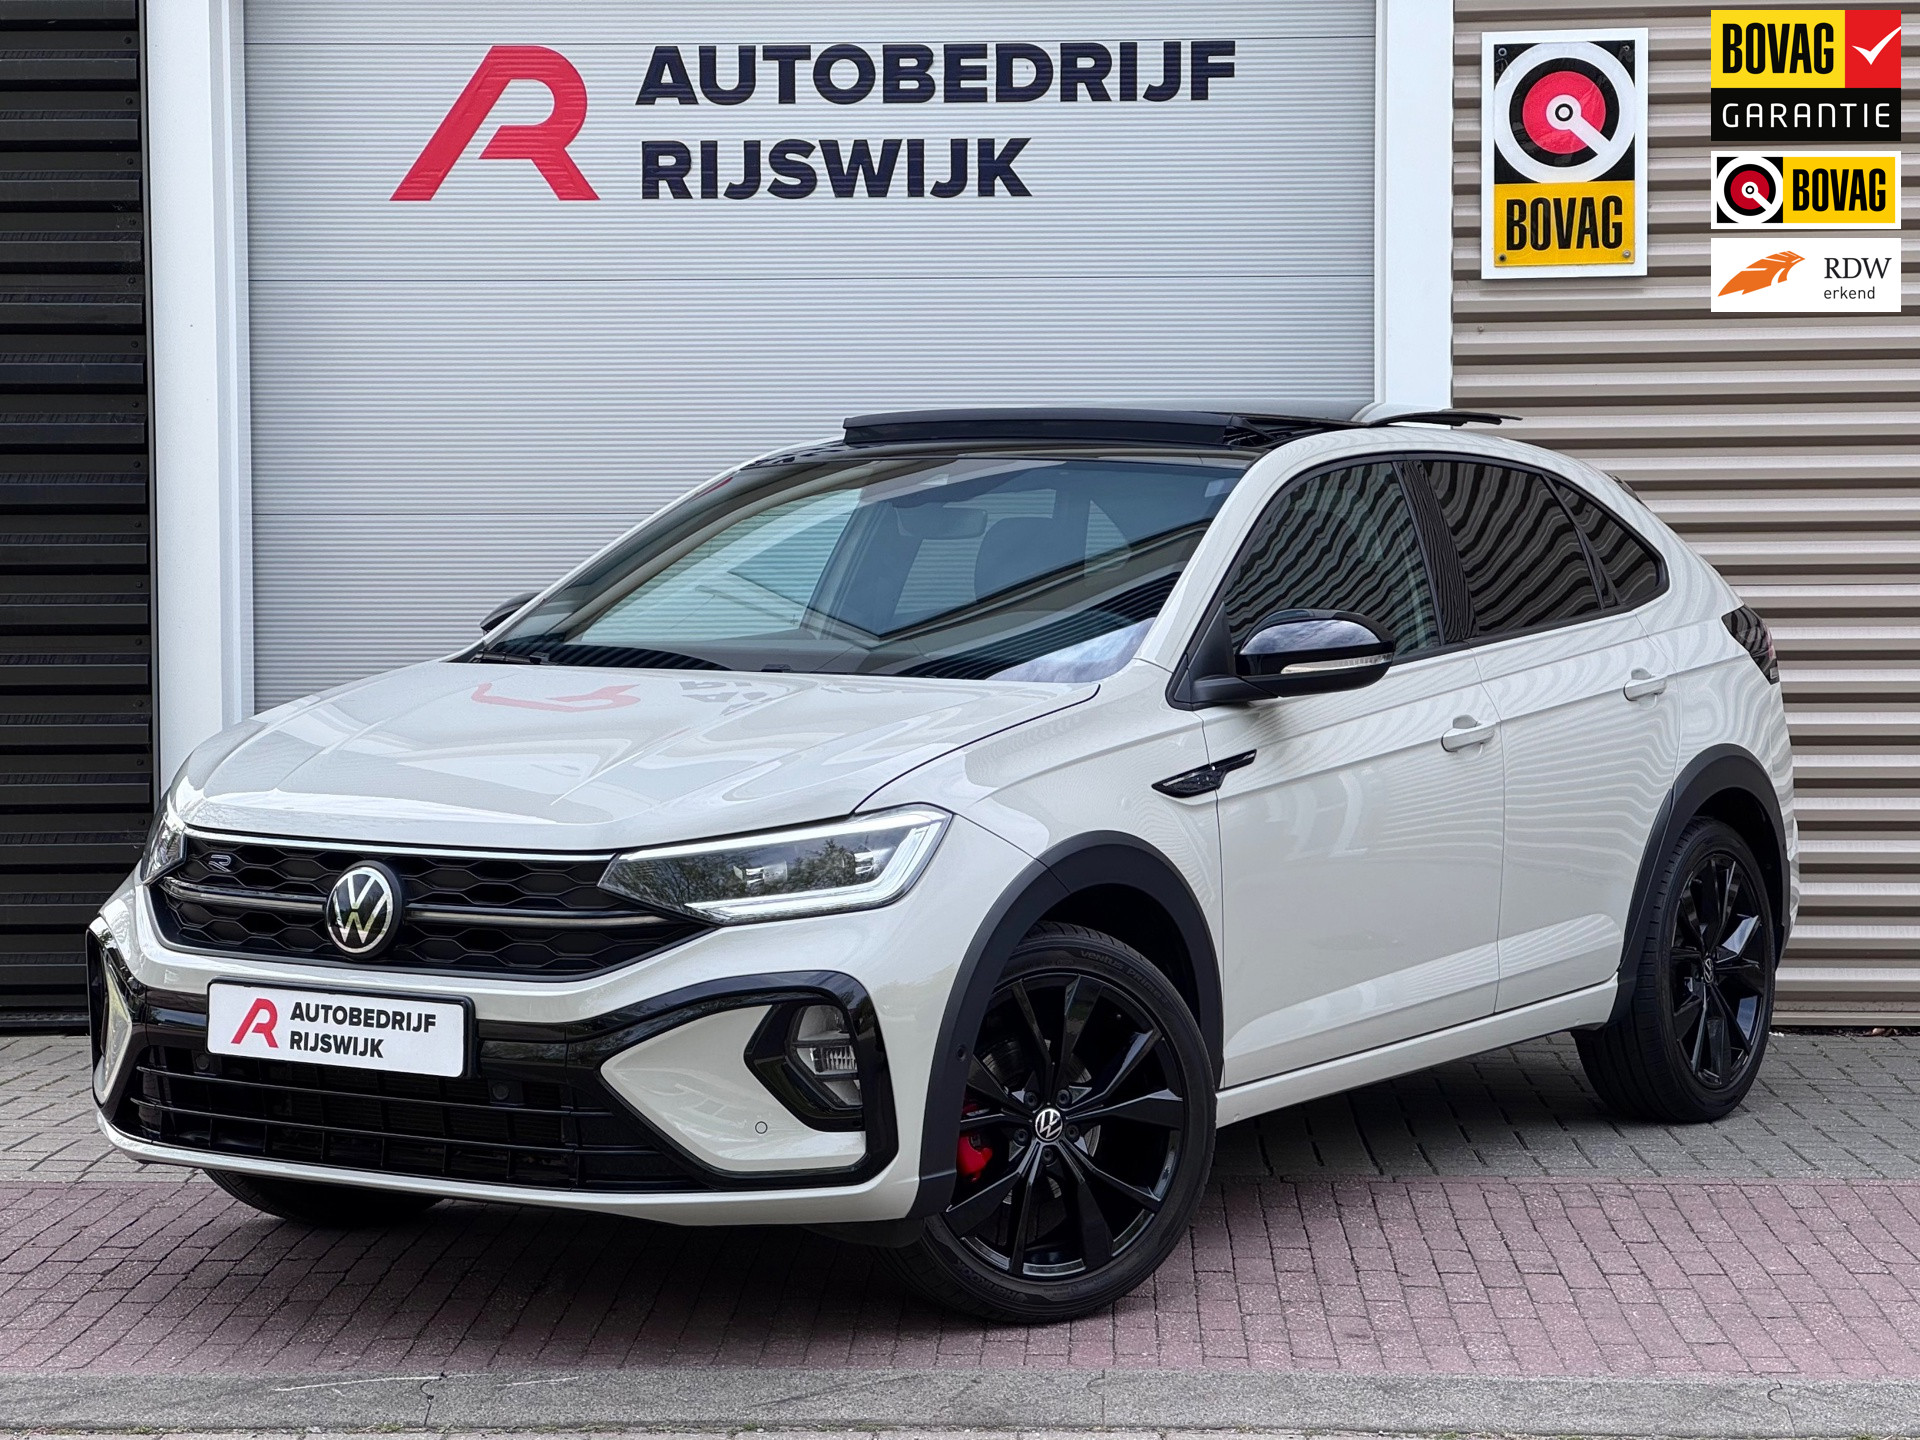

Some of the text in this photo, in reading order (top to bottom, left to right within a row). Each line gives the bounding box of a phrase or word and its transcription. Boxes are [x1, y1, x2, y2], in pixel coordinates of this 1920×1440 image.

[635, 40, 1236, 106] AUTOBEDRIJF
[641, 137, 1033, 200] RIJSWIJK
[1506, 195, 1623, 251] BOVAG
[289, 1030, 384, 1059] RIJSWIJK
[290, 1001, 437, 1033] AUTOBEDRIJF
